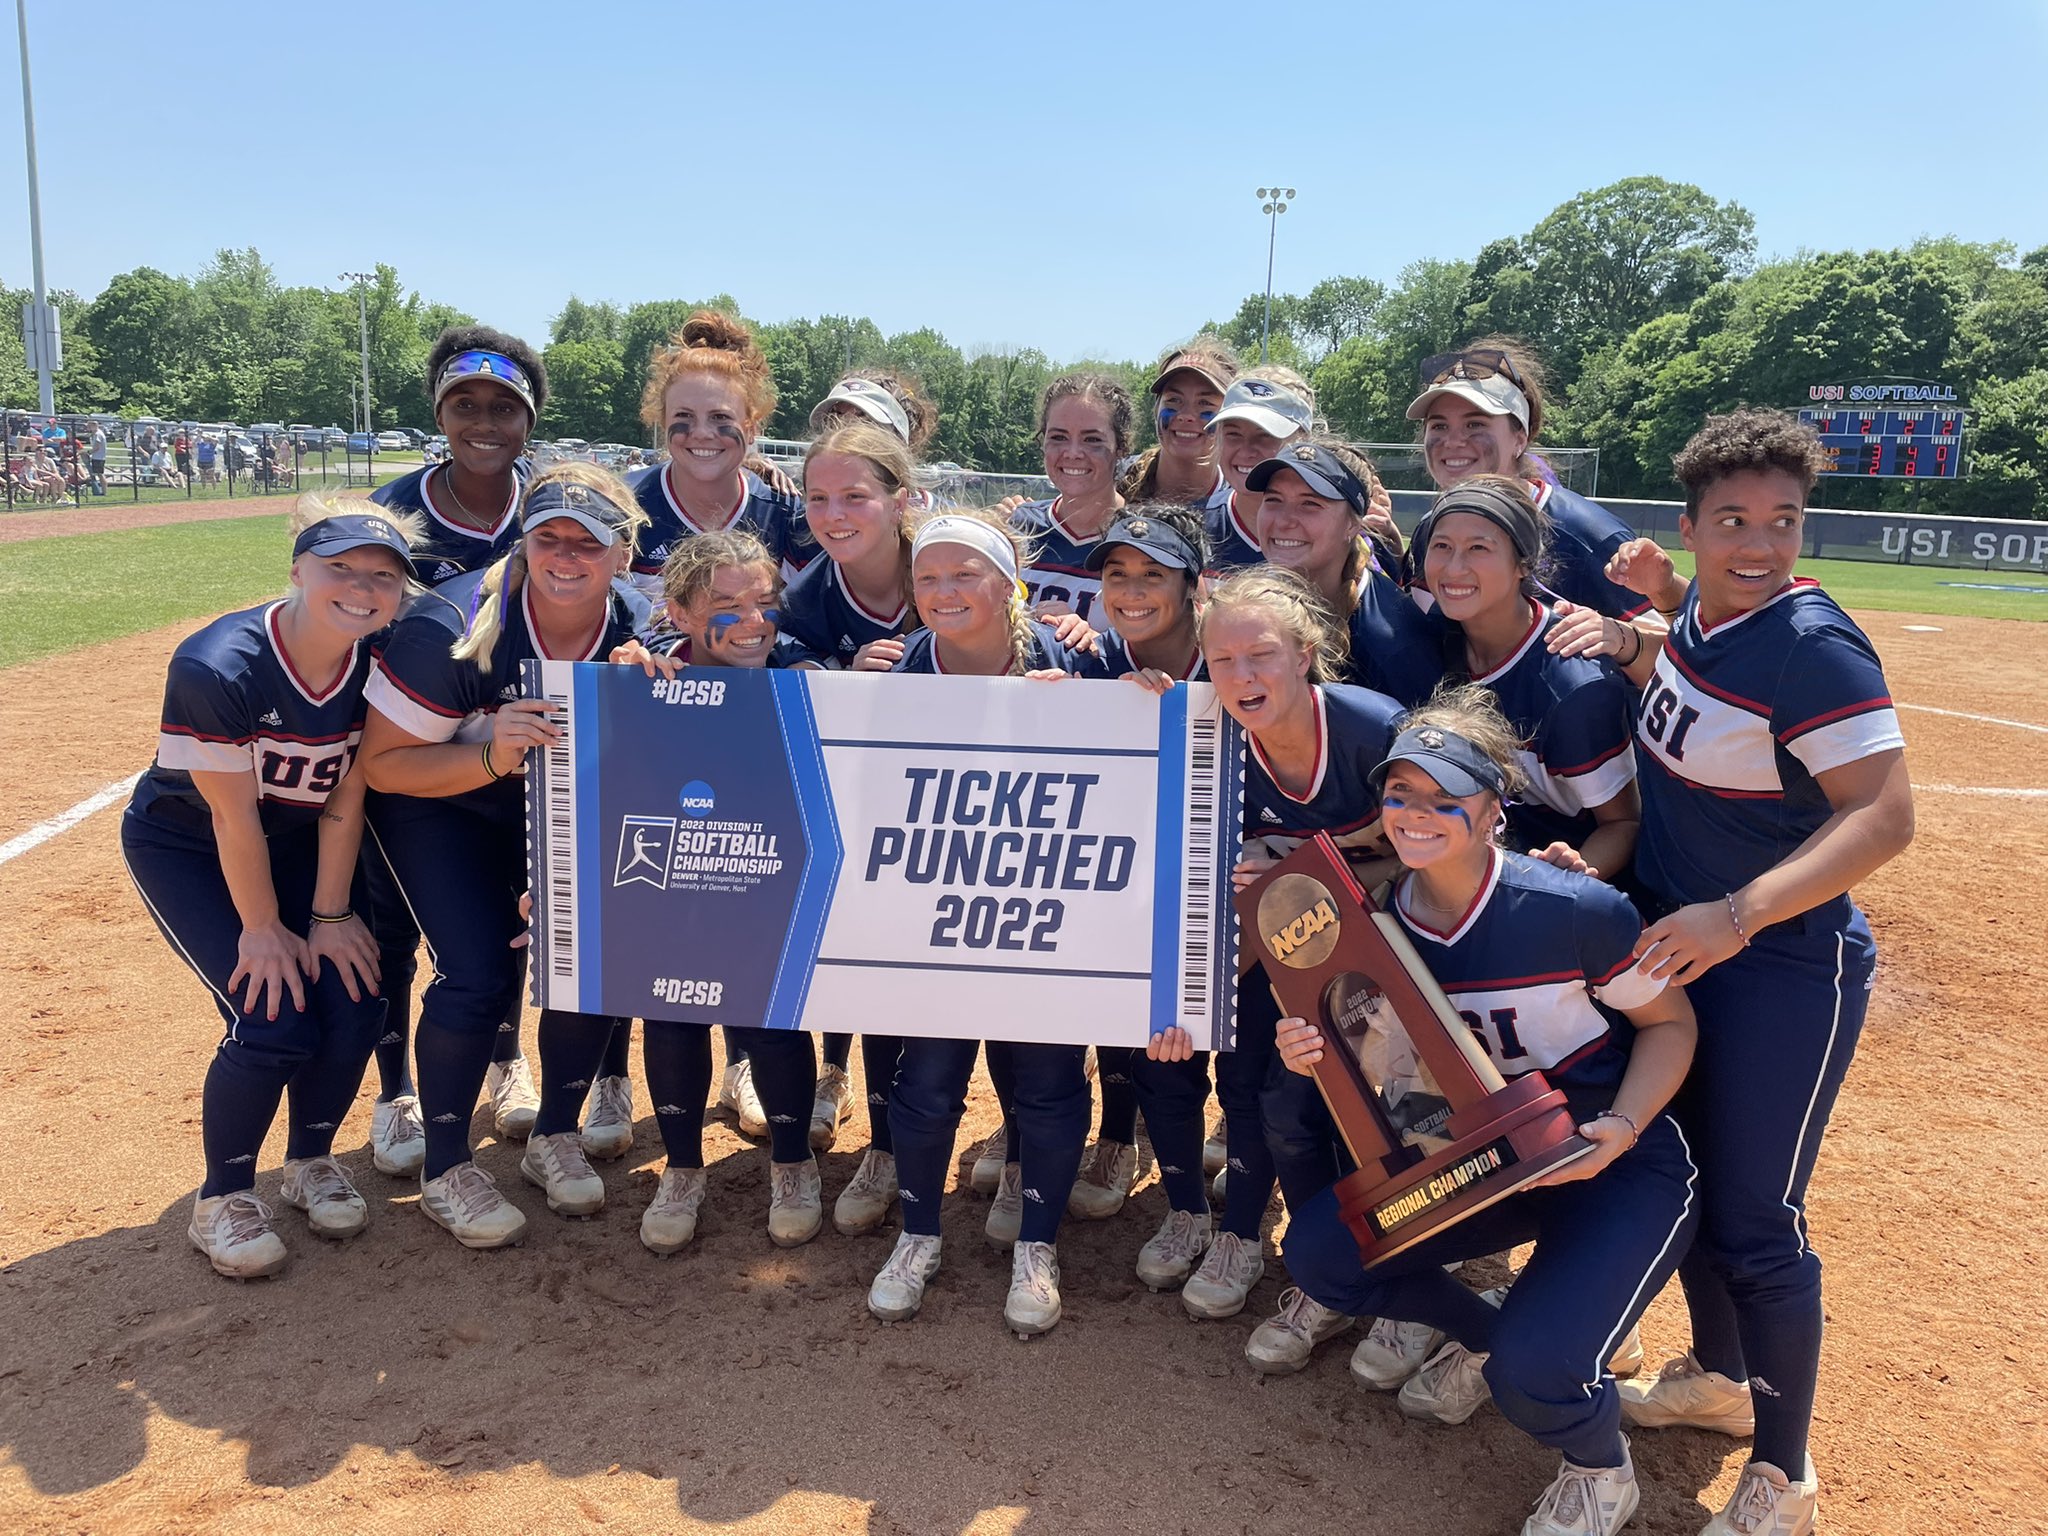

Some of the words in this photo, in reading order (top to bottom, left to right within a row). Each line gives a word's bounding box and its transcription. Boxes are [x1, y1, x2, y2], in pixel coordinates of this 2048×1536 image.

[1809, 385, 1844, 400] USI
[1849, 385, 1958, 401] SOFTBALL
[1822, 420, 1830, 433] 7
[1861, 420, 1872, 435] 2
[1904, 420, 1915, 436] 2
[1942, 420, 1953, 436] 2
[1871, 445, 1882, 460] 3
[1907, 446, 1918, 460] 4
[1936, 446, 1948, 462] 0
[1869, 460, 1880, 477] 2
[1905, 461, 1916, 476] 8
[367, 520, 388, 532] USI
[1881, 526, 1953, 558] USI
[651, 678, 727, 706] #D2SB
[682, 797, 714, 808] NCAA
[903, 767, 1100, 830] TICKET
[680, 820, 704, 830] 2022
[706, 821, 752, 832] DIVISION
[752, 823, 763, 833] II
[676, 831, 778, 857] SOFTBALL
[673, 855, 783, 875] CHAMPIONSHIP
[864, 826, 1138, 892] PUNCHED
[669, 881, 700, 892] University
[700, 883, 708, 891] of
[708, 883, 732, 892] Denver,
[732, 885, 747, 893] Host
[671, 872, 699, 881] DENVER
[703, 874, 743, 885] Metropolitan
[743, 875, 761, 884] State
[928, 894, 1066, 953] 2022
[1270, 899, 1336, 960] NCAA
[652, 977, 724, 1007] #D2SB
[1346, 988, 1369, 1010] 2022
[1456, 1007, 1529, 1060] SI
[1413, 1106, 1453, 1132] SOFTBALL
[1375, 1187, 1432, 1230] REGIONAL
[1428, 1147, 1502, 1201] CHAMPION
